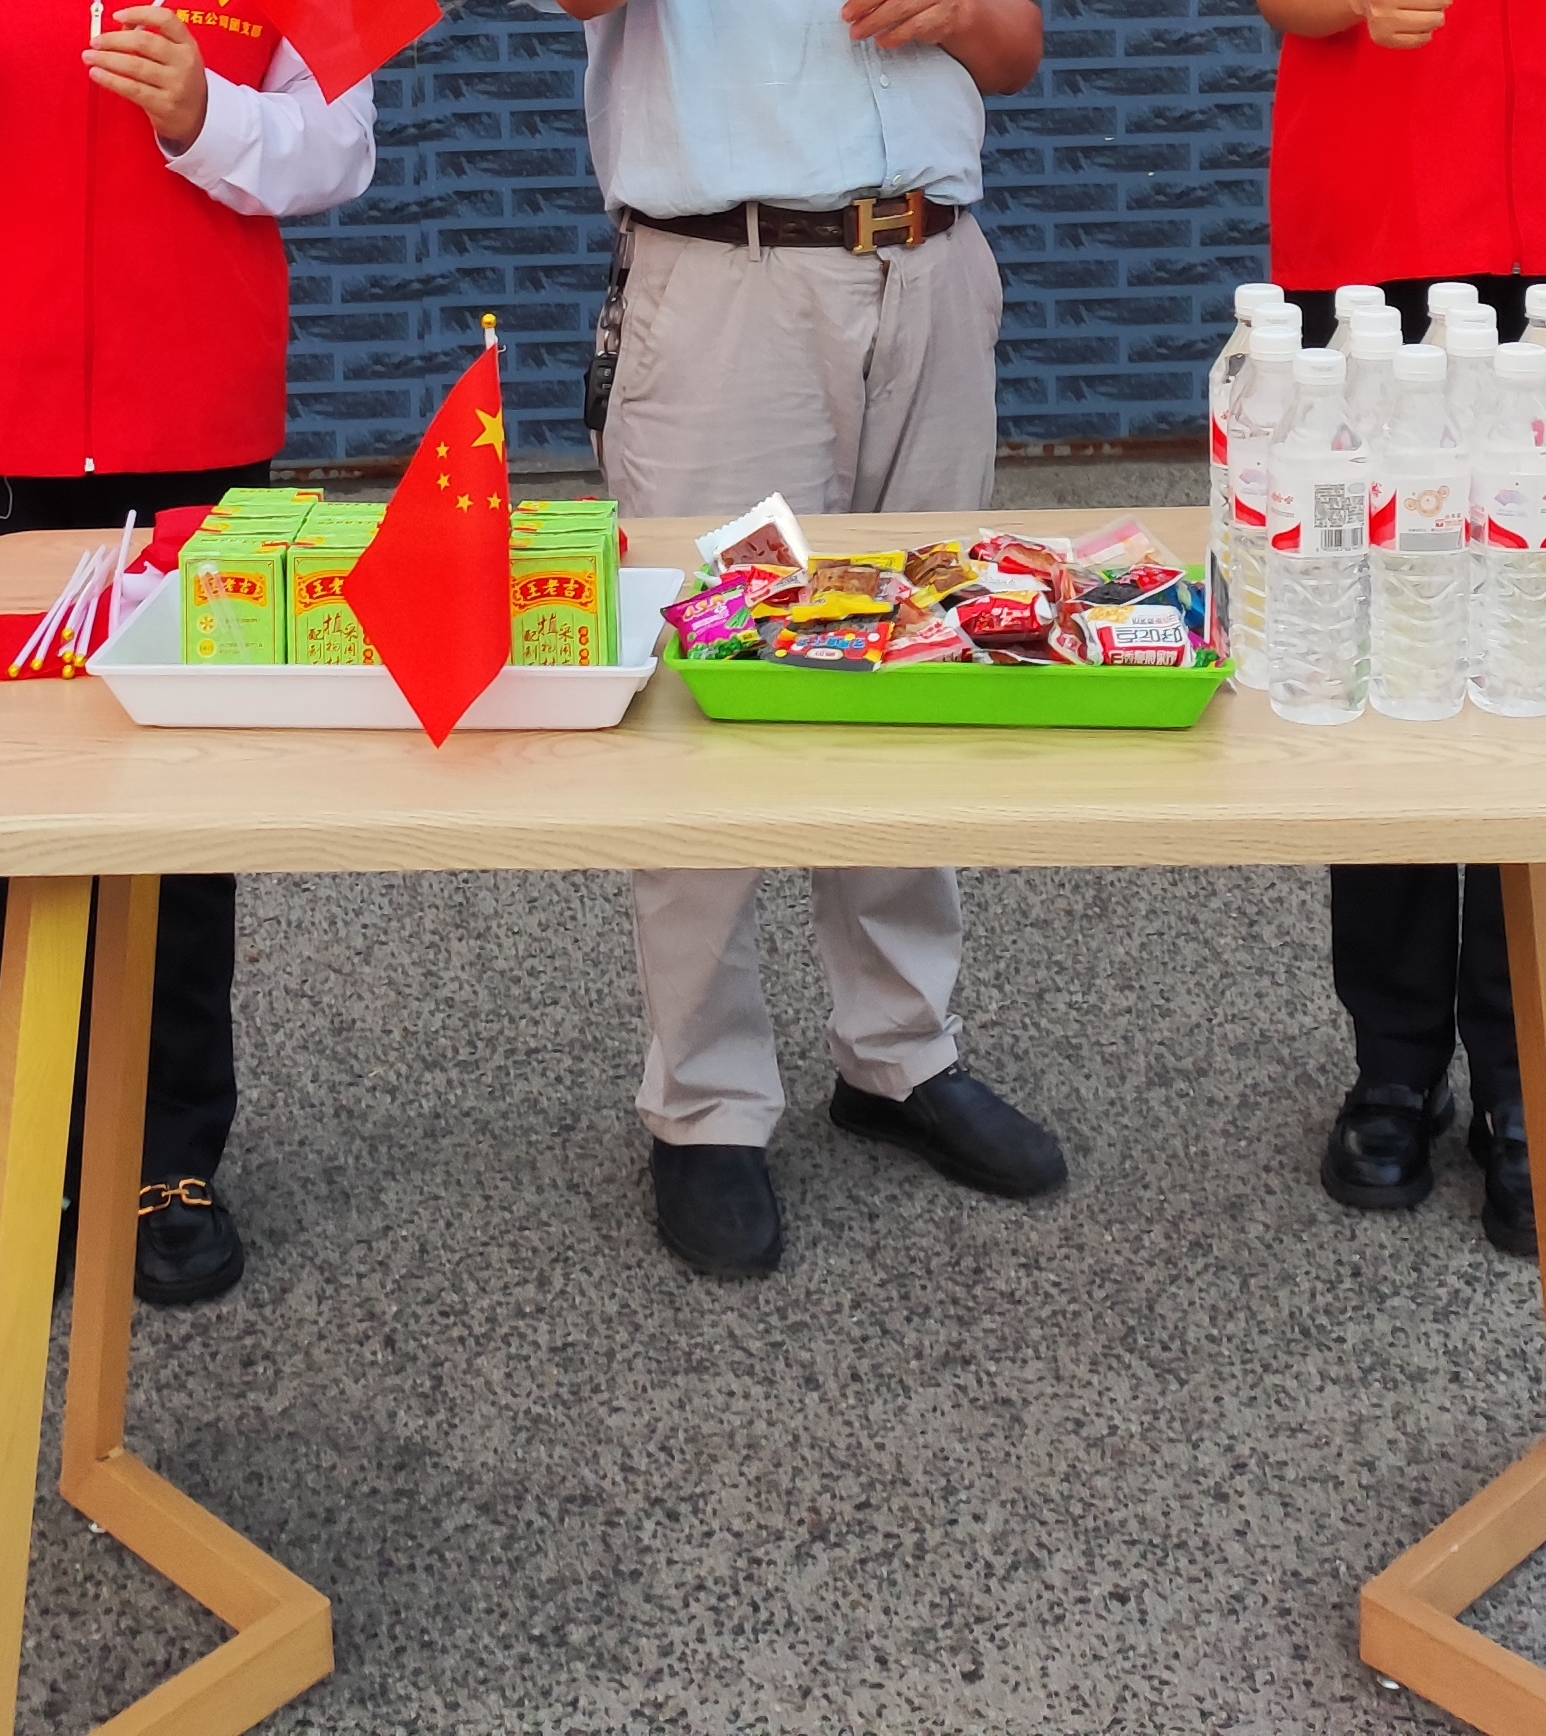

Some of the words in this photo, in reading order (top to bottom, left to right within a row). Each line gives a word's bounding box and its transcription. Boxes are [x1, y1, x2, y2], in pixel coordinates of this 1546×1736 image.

[312, 577, 344, 599] 王老
[527, 579, 580, 599] 王老吉
